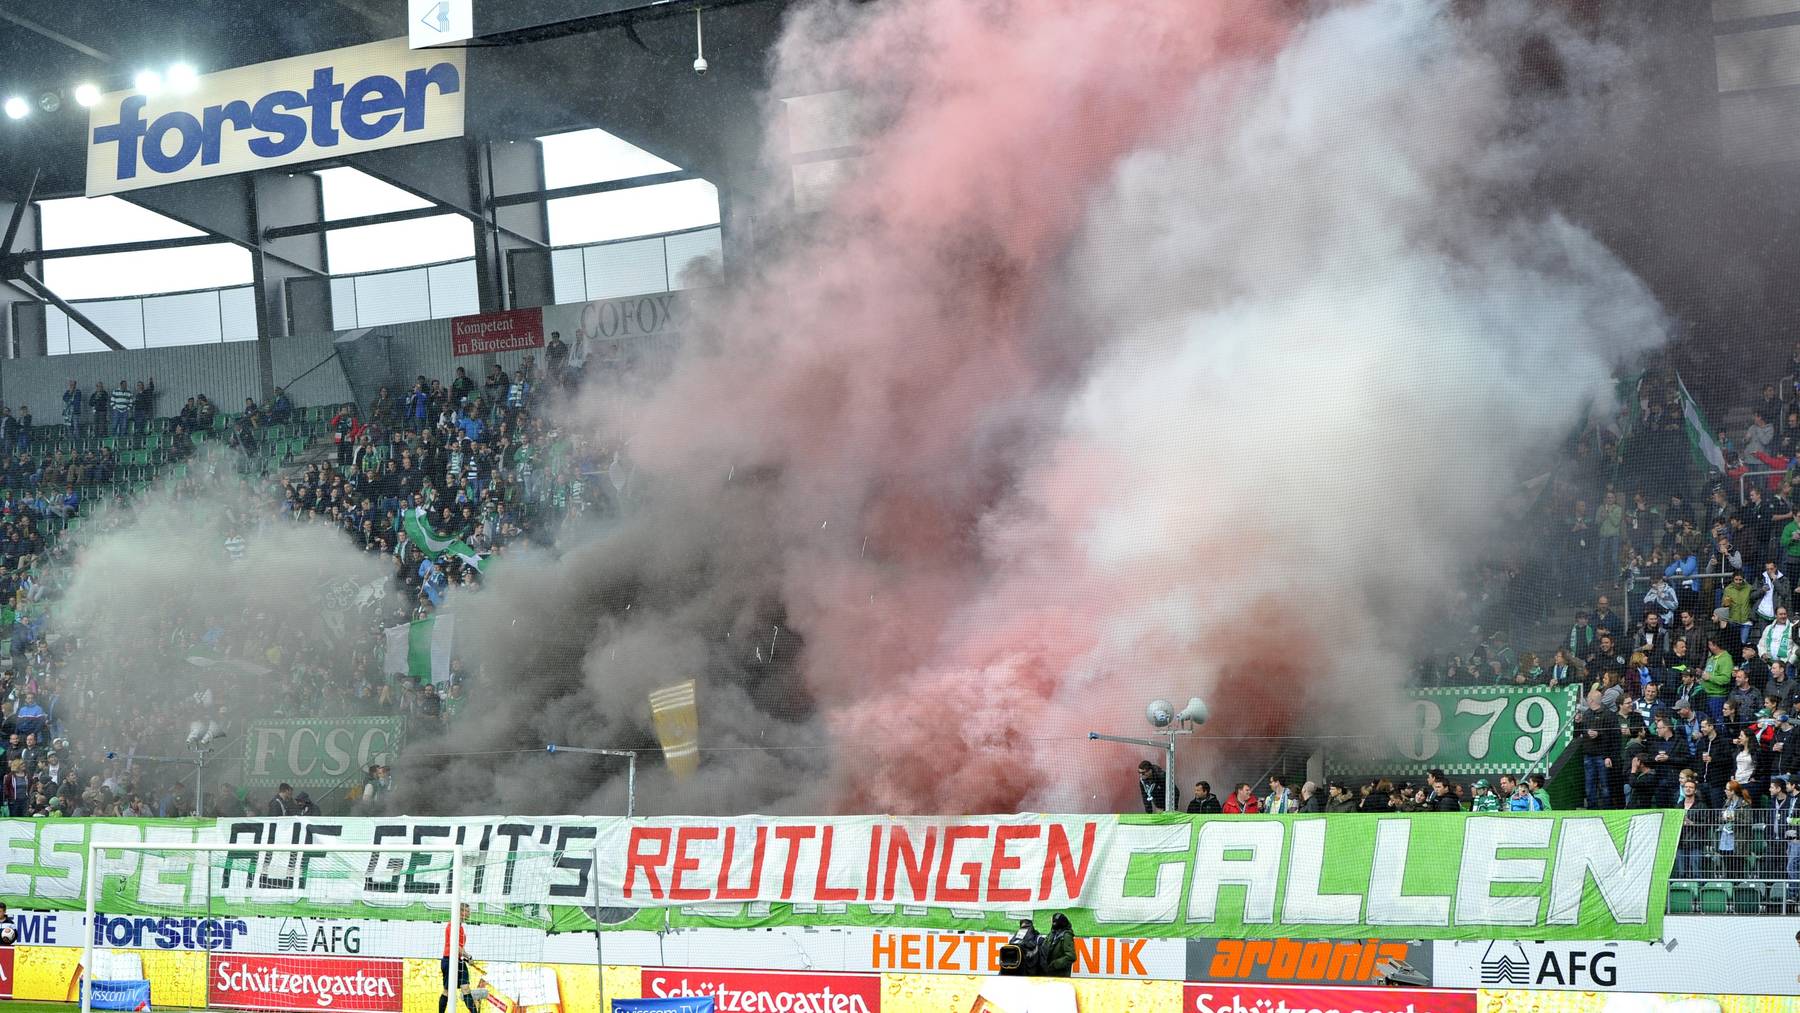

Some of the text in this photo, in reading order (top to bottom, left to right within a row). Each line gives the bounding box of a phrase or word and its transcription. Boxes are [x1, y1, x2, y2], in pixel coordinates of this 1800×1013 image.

[93, 62, 460, 180] forster
[456, 317, 514, 337] Kompetent
[580, 295, 675, 340] COFOX
[457, 333, 535, 354] in Bürotechnik
[250, 727, 391, 777] FCSG
[221, 822, 1098, 902] AUF GEHT'S REUTLINGEN
[1096, 814, 1664, 926] GALLEN
[311, 925, 361, 953] AFG
[871, 933, 1150, 976] HEIZTENIK
[217, 961, 396, 1007] Schützengarten
[1535, 950, 1617, 987] AFG
